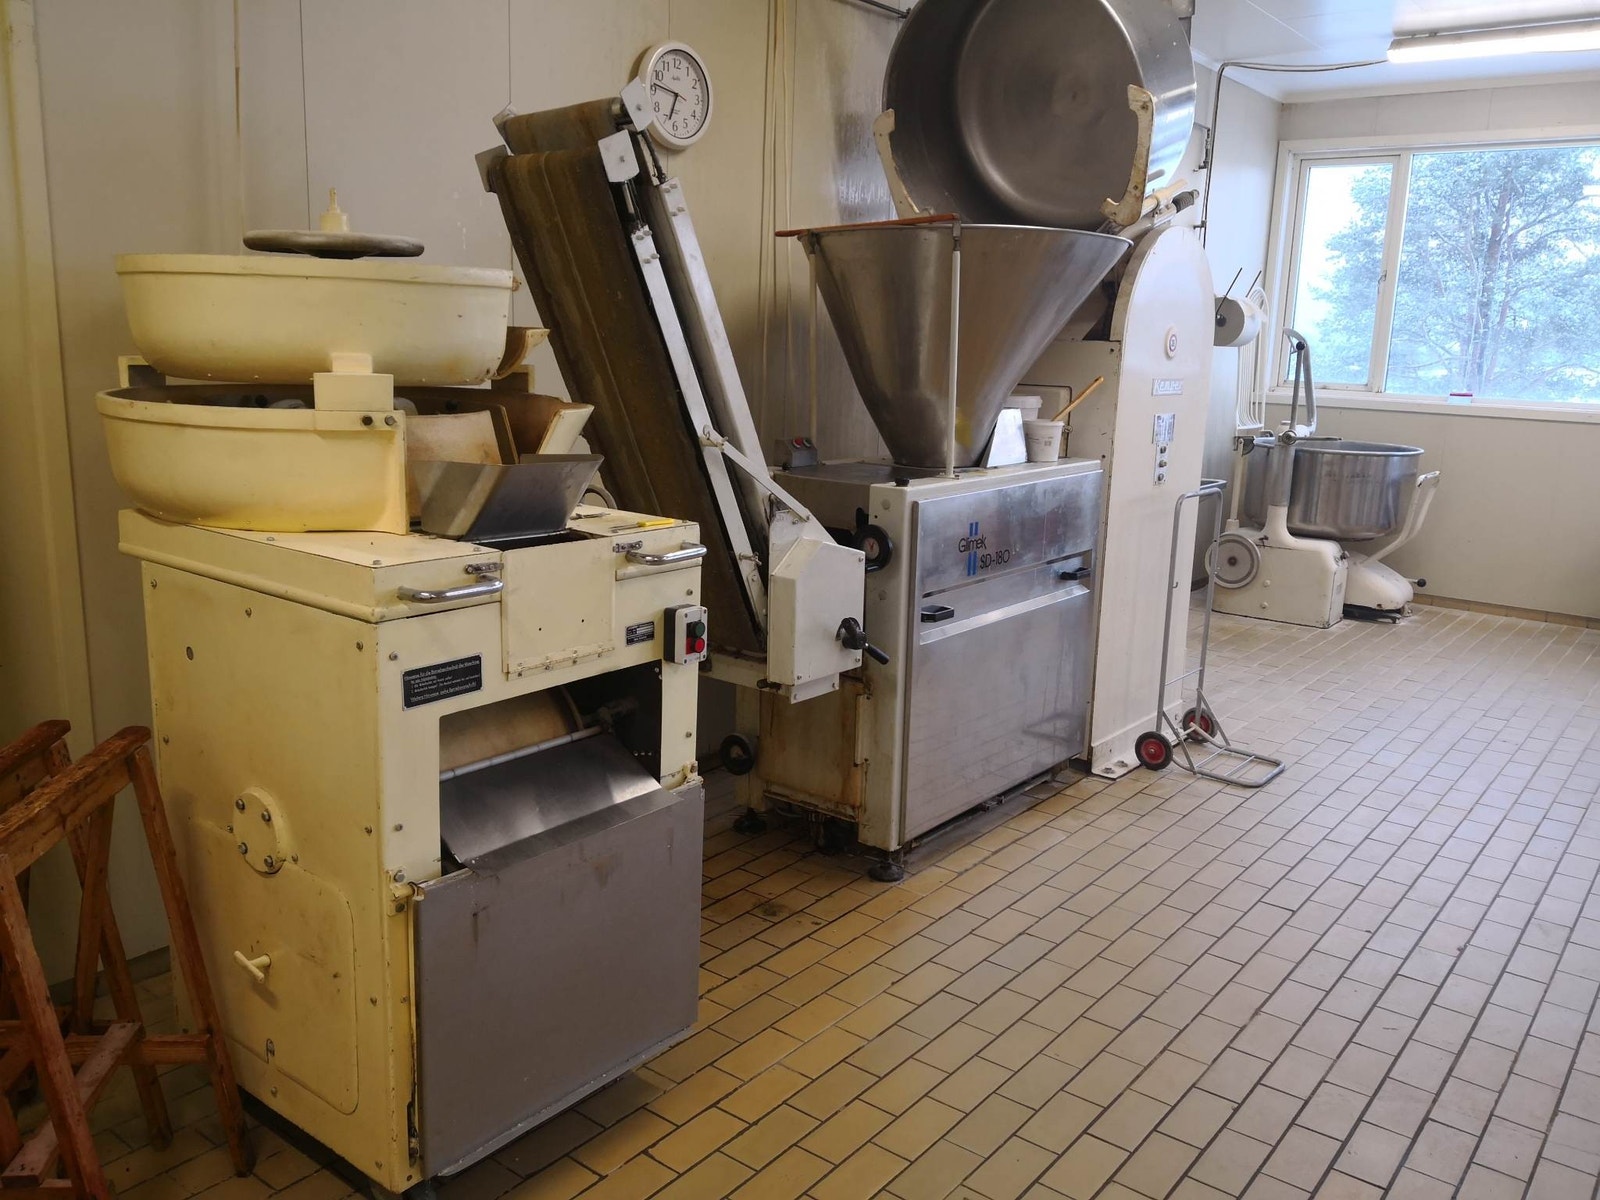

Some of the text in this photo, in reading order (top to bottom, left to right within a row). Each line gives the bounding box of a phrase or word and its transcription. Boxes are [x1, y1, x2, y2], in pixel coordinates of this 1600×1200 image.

[662, 60, 670, 72] 11
[672, 57, 681, 70] 12
[654, 69, 664, 82] 10
[685, 66, 690, 77] 1
[650, 84, 657, 96] 9
[692, 78, 697, 90] 2
[694, 94, 700, 106] 3
[653, 101, 660, 113] 8
[663, 113, 669, 124] 7
[690, 109, 696, 120] 4
[672, 120, 678, 132] 6
[683, 118, 688, 129] 5
[958, 533, 987, 553] Glimek
[979, 549, 1011, 569] SD-180
